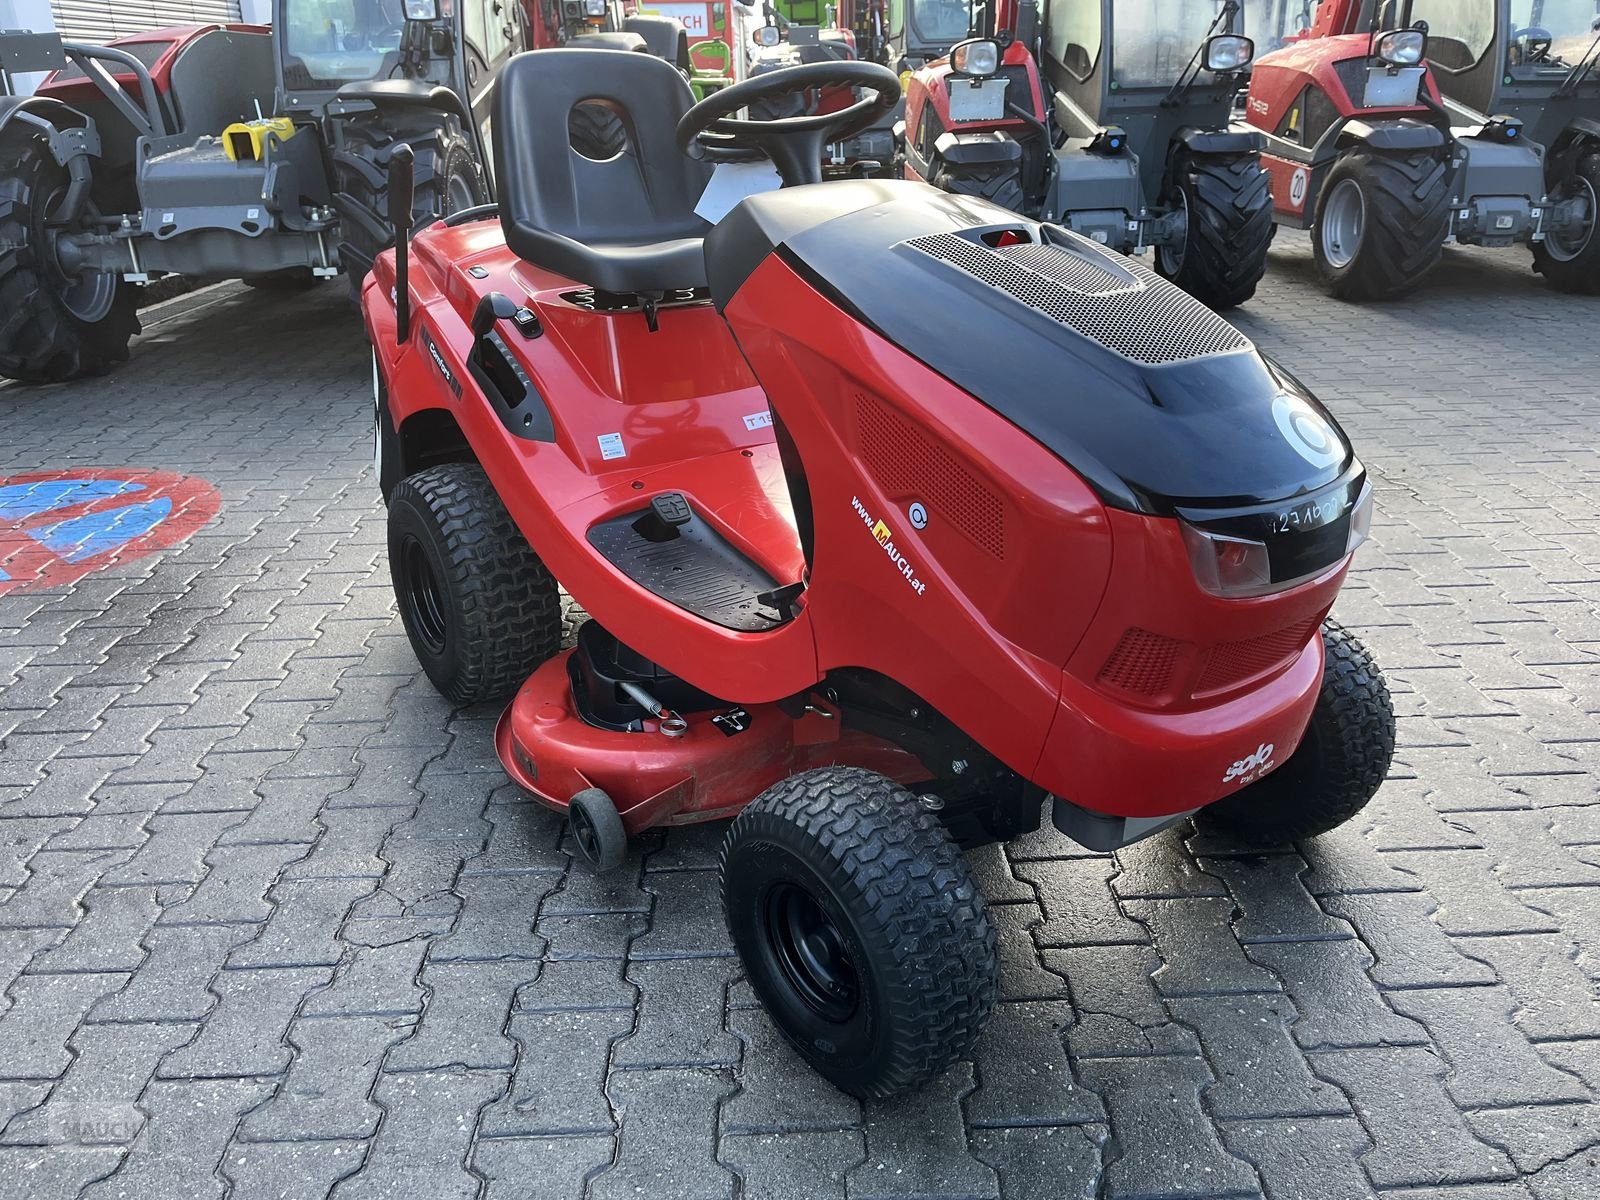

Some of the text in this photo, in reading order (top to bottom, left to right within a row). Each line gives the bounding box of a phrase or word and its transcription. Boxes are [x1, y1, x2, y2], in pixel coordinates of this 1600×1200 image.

[1293, 174, 1304, 200] 20
[429, 342, 450, 380] Comfort
[747, 418, 755, 427] T
[851, 495, 926, 596] www.MAUCH.at
[1222, 743, 1274, 783] solo
